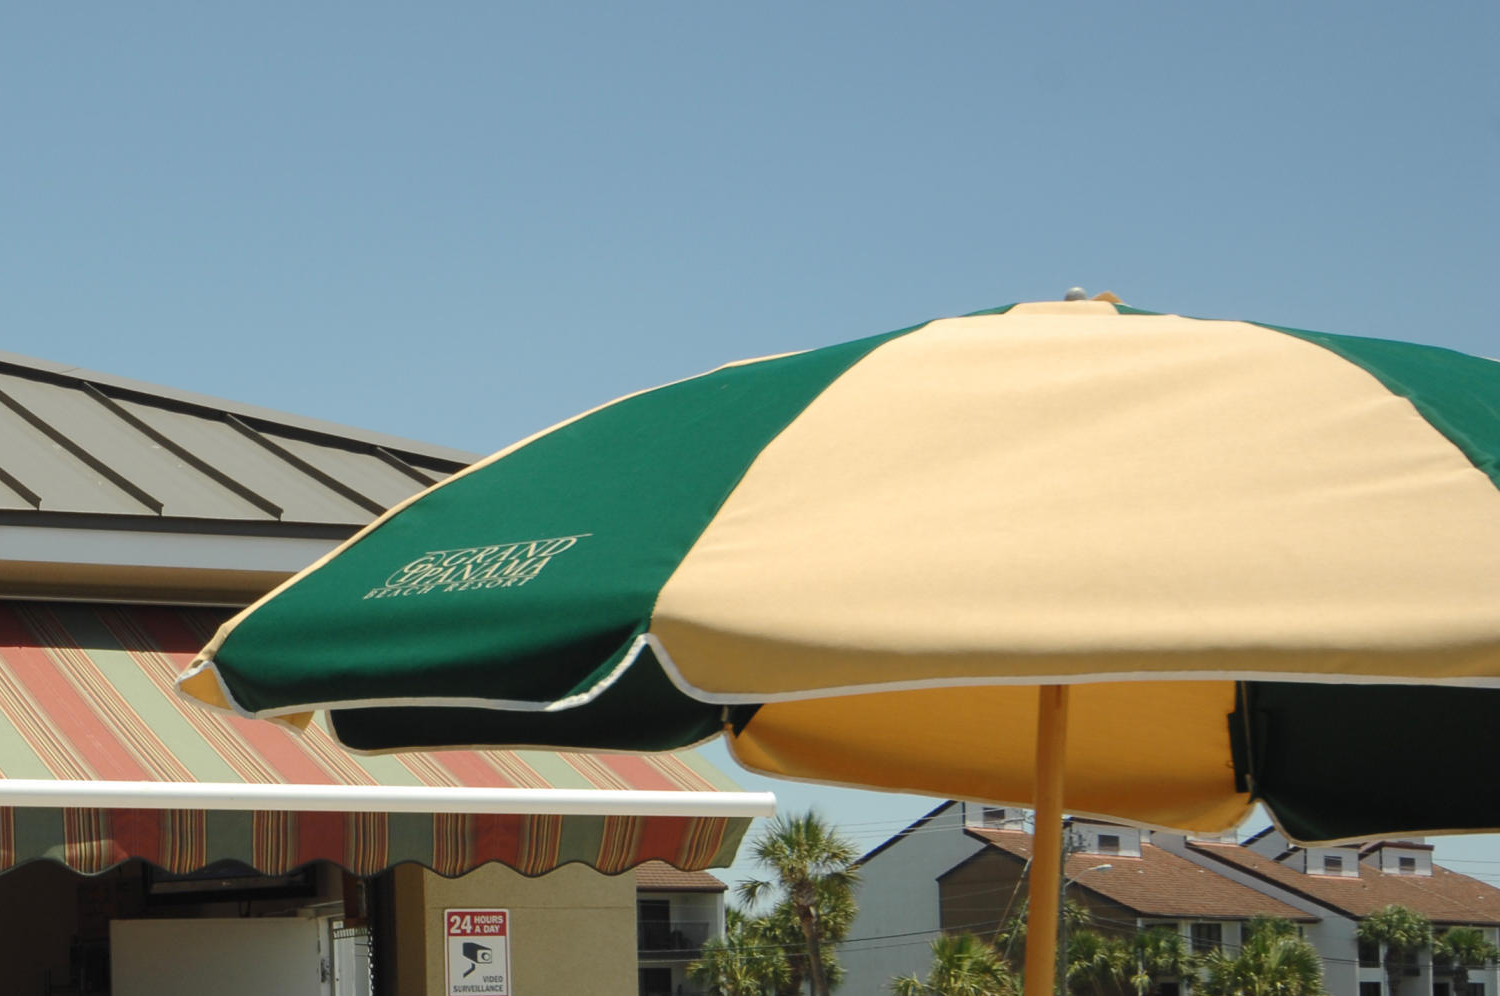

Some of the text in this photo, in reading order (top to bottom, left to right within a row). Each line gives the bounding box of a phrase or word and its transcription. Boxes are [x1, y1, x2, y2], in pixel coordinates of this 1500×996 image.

[442, 537, 578, 567] GRAND
[411, 557, 552, 586] PANAMA
[363, 576, 537, 600] BEACH RESORT
[449, 914, 504, 934] 24 HOURS
[474, 925, 501, 934] A DAY
[452, 984, 504, 993] SURVEILLANCE
[482, 975, 504, 983] VIDEO
